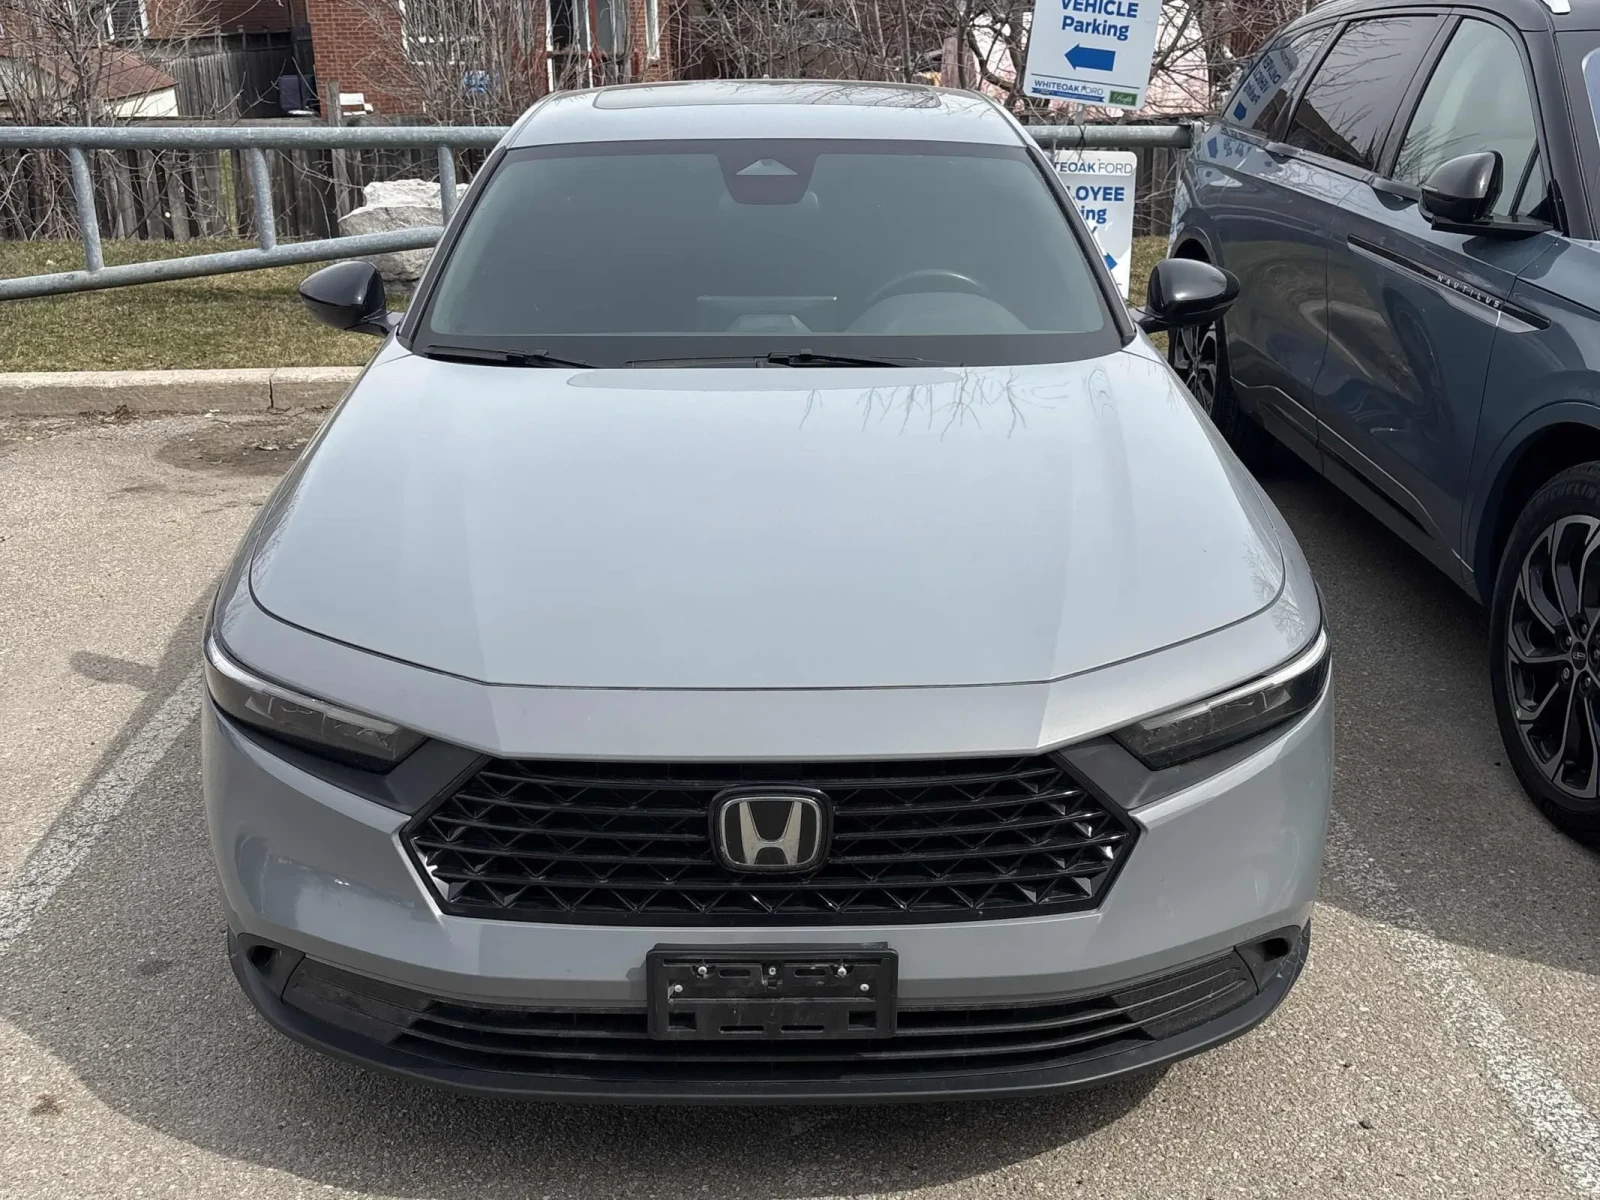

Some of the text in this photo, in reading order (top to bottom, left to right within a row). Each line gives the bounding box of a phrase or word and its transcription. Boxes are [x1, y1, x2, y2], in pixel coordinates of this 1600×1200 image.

[1061, 0, 1139, 18] VEHICLE
[1062, 15, 1130, 41] Parking
[1034, 79, 1080, 93] WHITEOAK
[1080, 85, 1104, 96] FORD
[1053, 161, 1133, 174] TEOAK FORD
[1068, 185, 1125, 202] OYEE
[1080, 205, 1107, 225] ing
[1437, 274, 1501, 308] NAUTILUS
